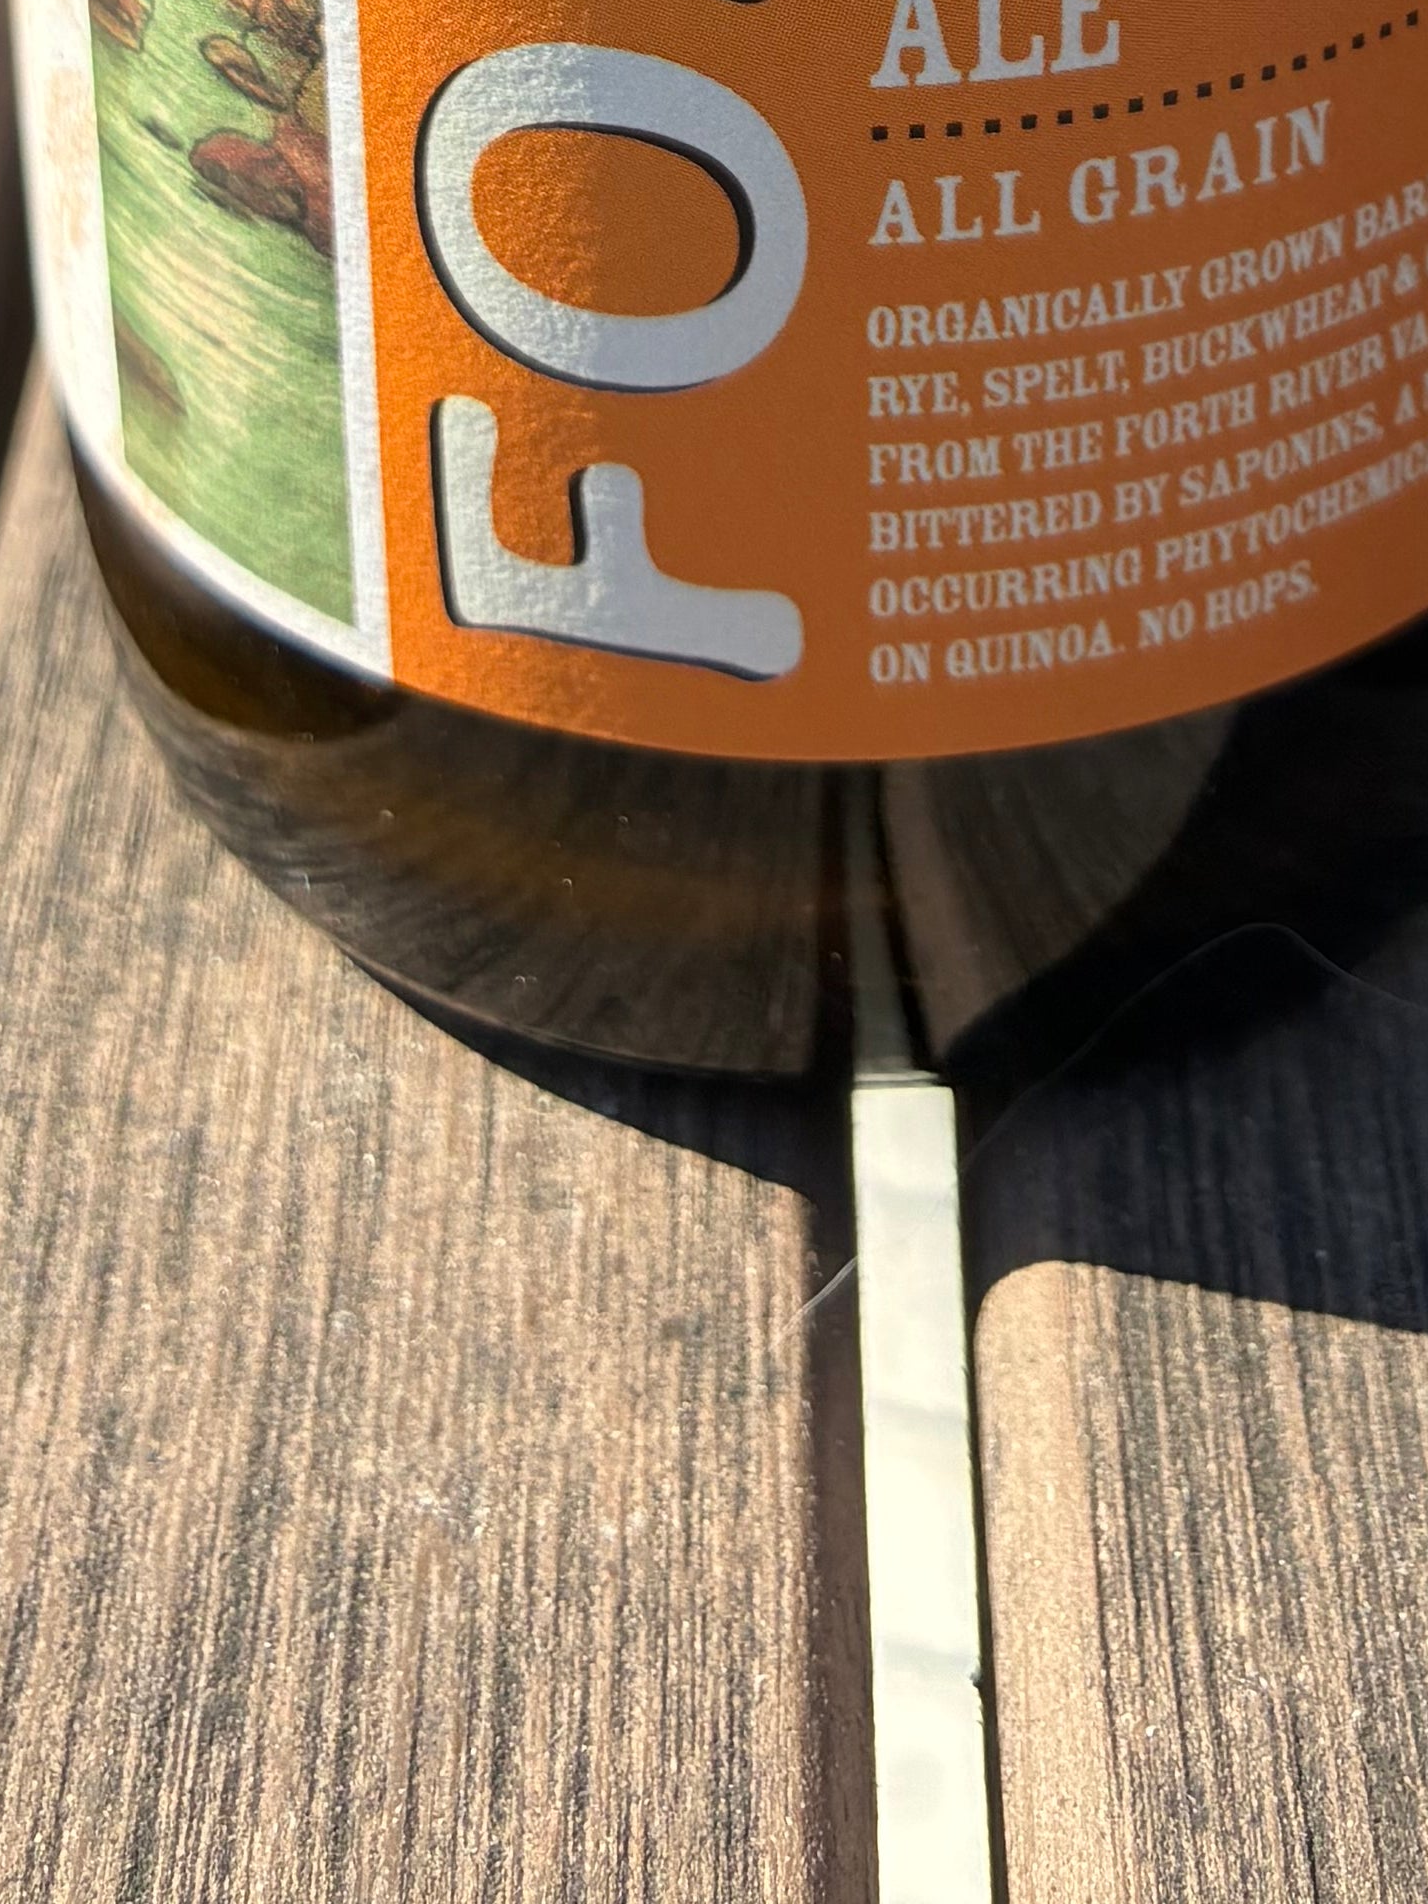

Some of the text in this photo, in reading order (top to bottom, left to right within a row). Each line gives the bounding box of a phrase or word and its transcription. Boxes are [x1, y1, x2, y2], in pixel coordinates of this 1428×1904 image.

[867, 100, 1332, 247] ALL GRAIN
[866, 265, 1191, 349] ORGANICALLY
[1199, 215, 1345, 301] GROWN
[867, 370, 972, 418] RYE,
[982, 349, 1130, 409] SPELT,
[1141, 263, 1389, 385] BUCKWHEAT
[1392, 252, 1419, 297] &
[868, 436, 1003, 485] FROM
[1012, 421, 1104, 473] THE
[1113, 382, 1257, 457] FORTH
[1269, 333, 1386, 417] RIVER
[868, 489, 1103, 554] BITTERED
[1113, 472, 1169, 524] BY
[1393, 382, 1418, 426] A
[868, 546, 1142, 618] OCCURRING
[869, 558, 1318, 684] ON QUINOA. NO HOPS.
